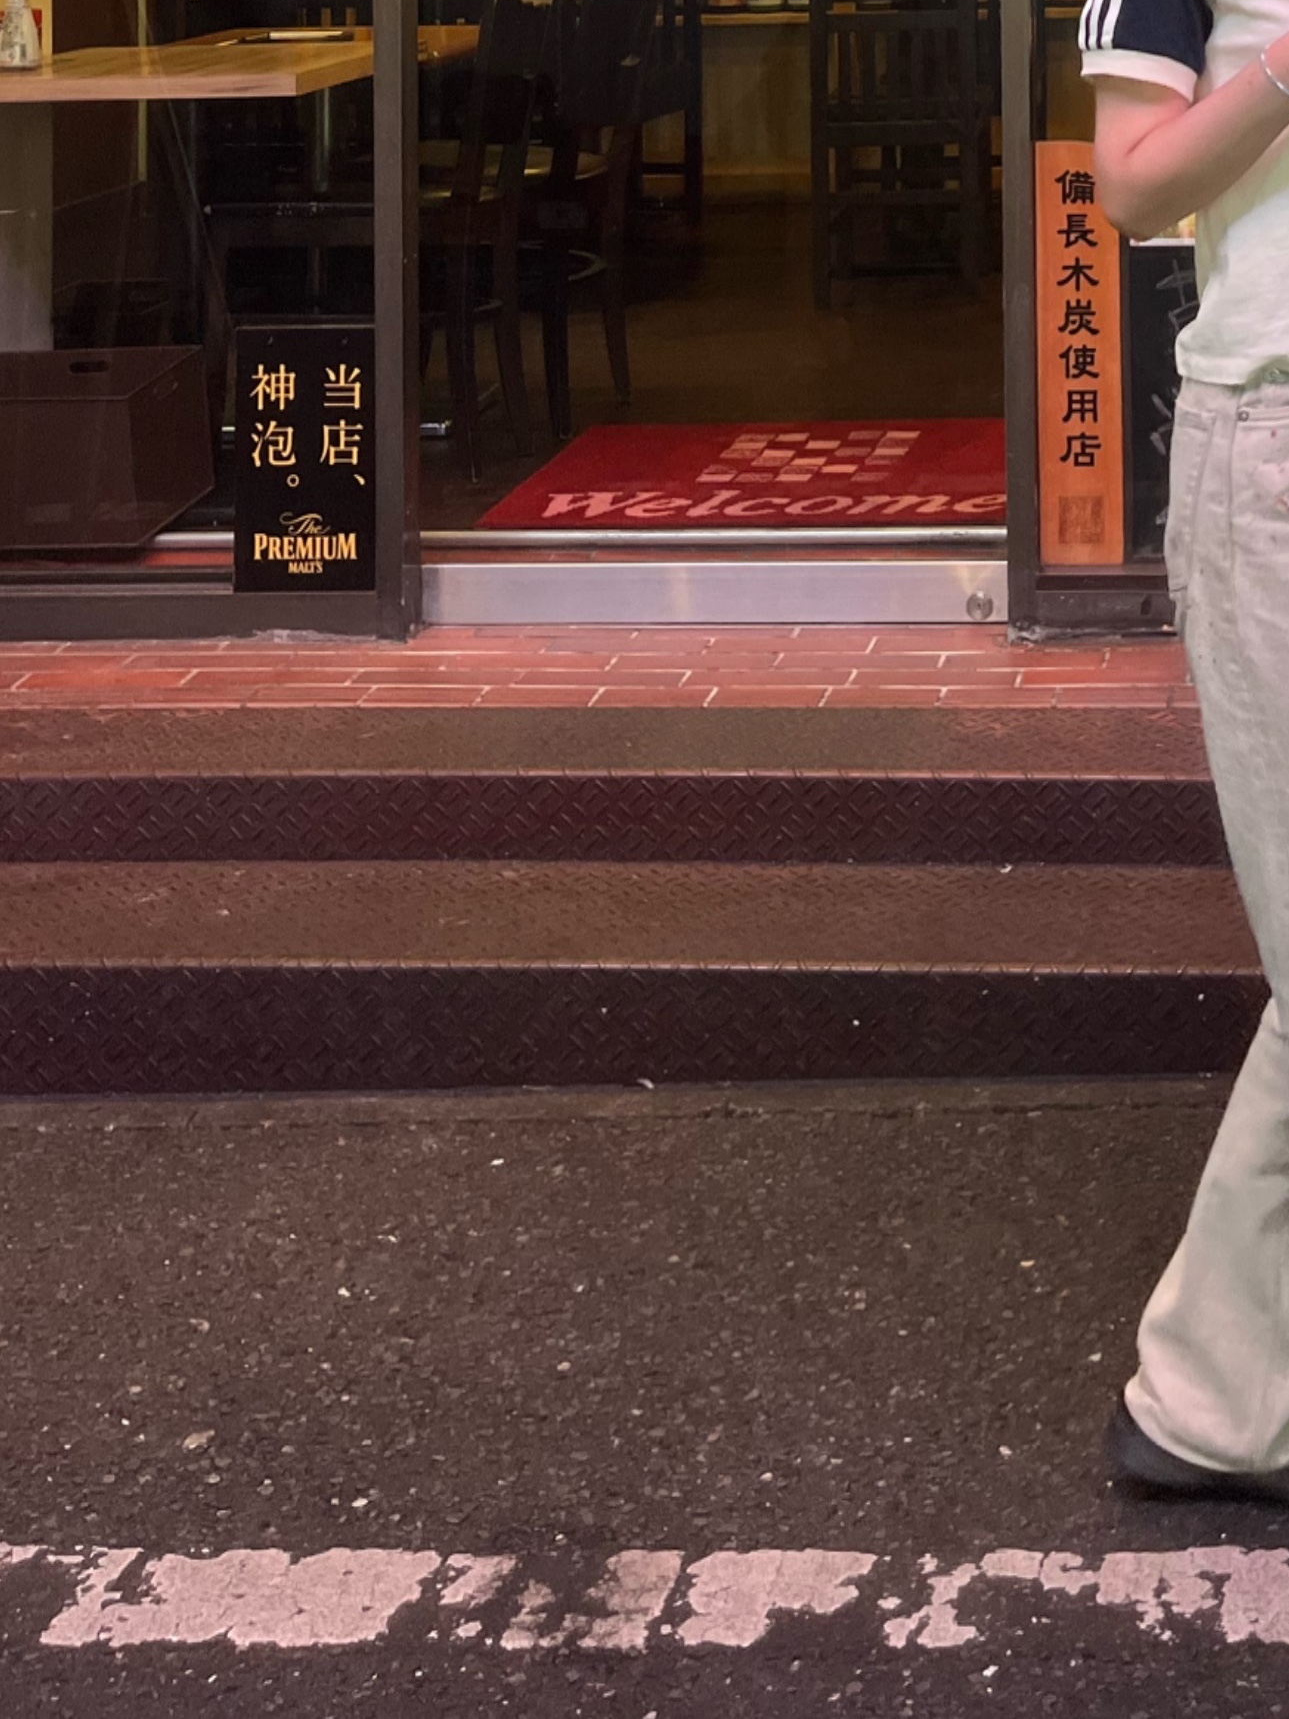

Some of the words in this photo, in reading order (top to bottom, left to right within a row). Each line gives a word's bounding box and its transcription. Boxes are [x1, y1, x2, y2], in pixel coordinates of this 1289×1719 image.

[1055, 169, 1102, 468] 備長木炭使用店
[250, 363, 300, 487] 神泡。
[320, 363, 366, 486] 当店、
[279, 511, 331, 535] The
[540, 489, 1007, 520] Welcome
[253, 532, 358, 561] PREMIUM
